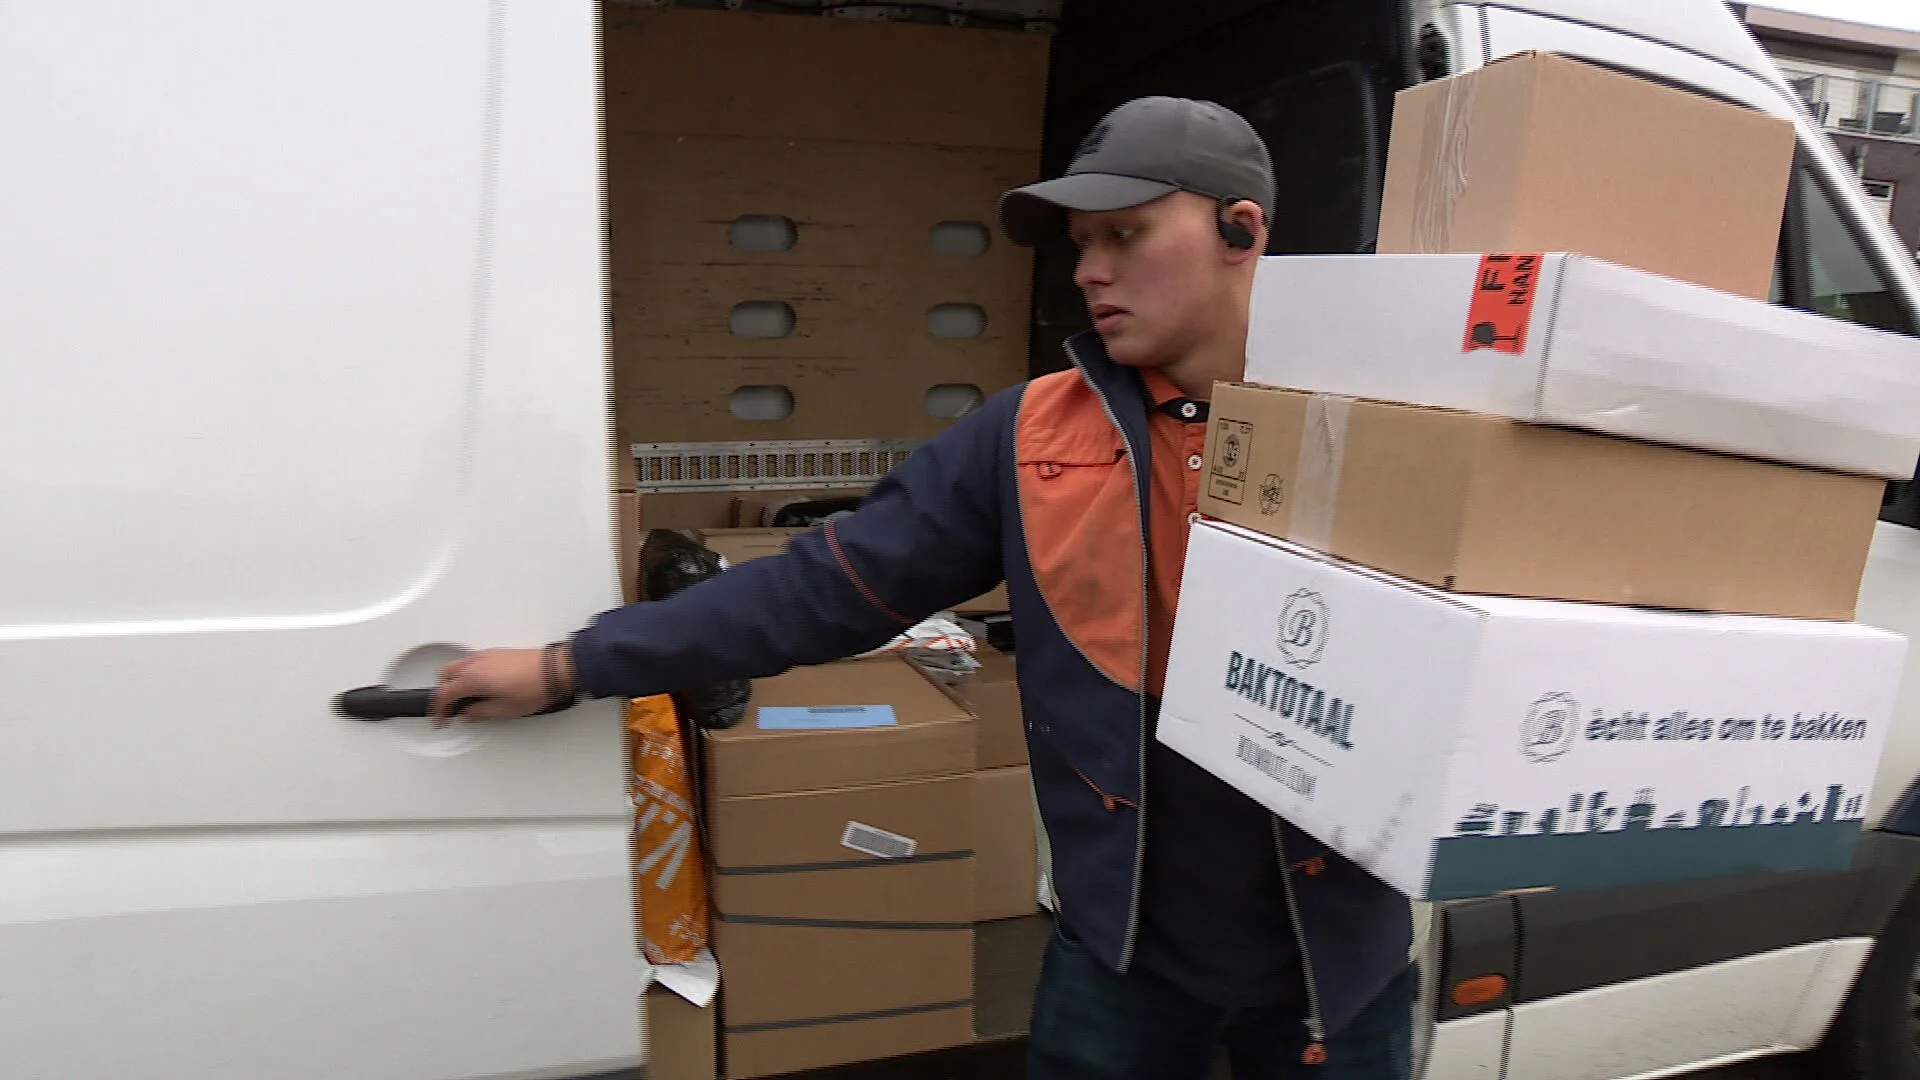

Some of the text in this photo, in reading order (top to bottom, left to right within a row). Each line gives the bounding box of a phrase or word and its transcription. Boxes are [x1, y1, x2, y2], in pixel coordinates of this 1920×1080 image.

[1224, 650, 1355, 751] BAKTOTAAL
[1652, 711, 1715, 741] alles
[1718, 717, 1757, 740] om
[1760, 713, 1786, 740] te
[1788, 711, 1869, 741] bakken
